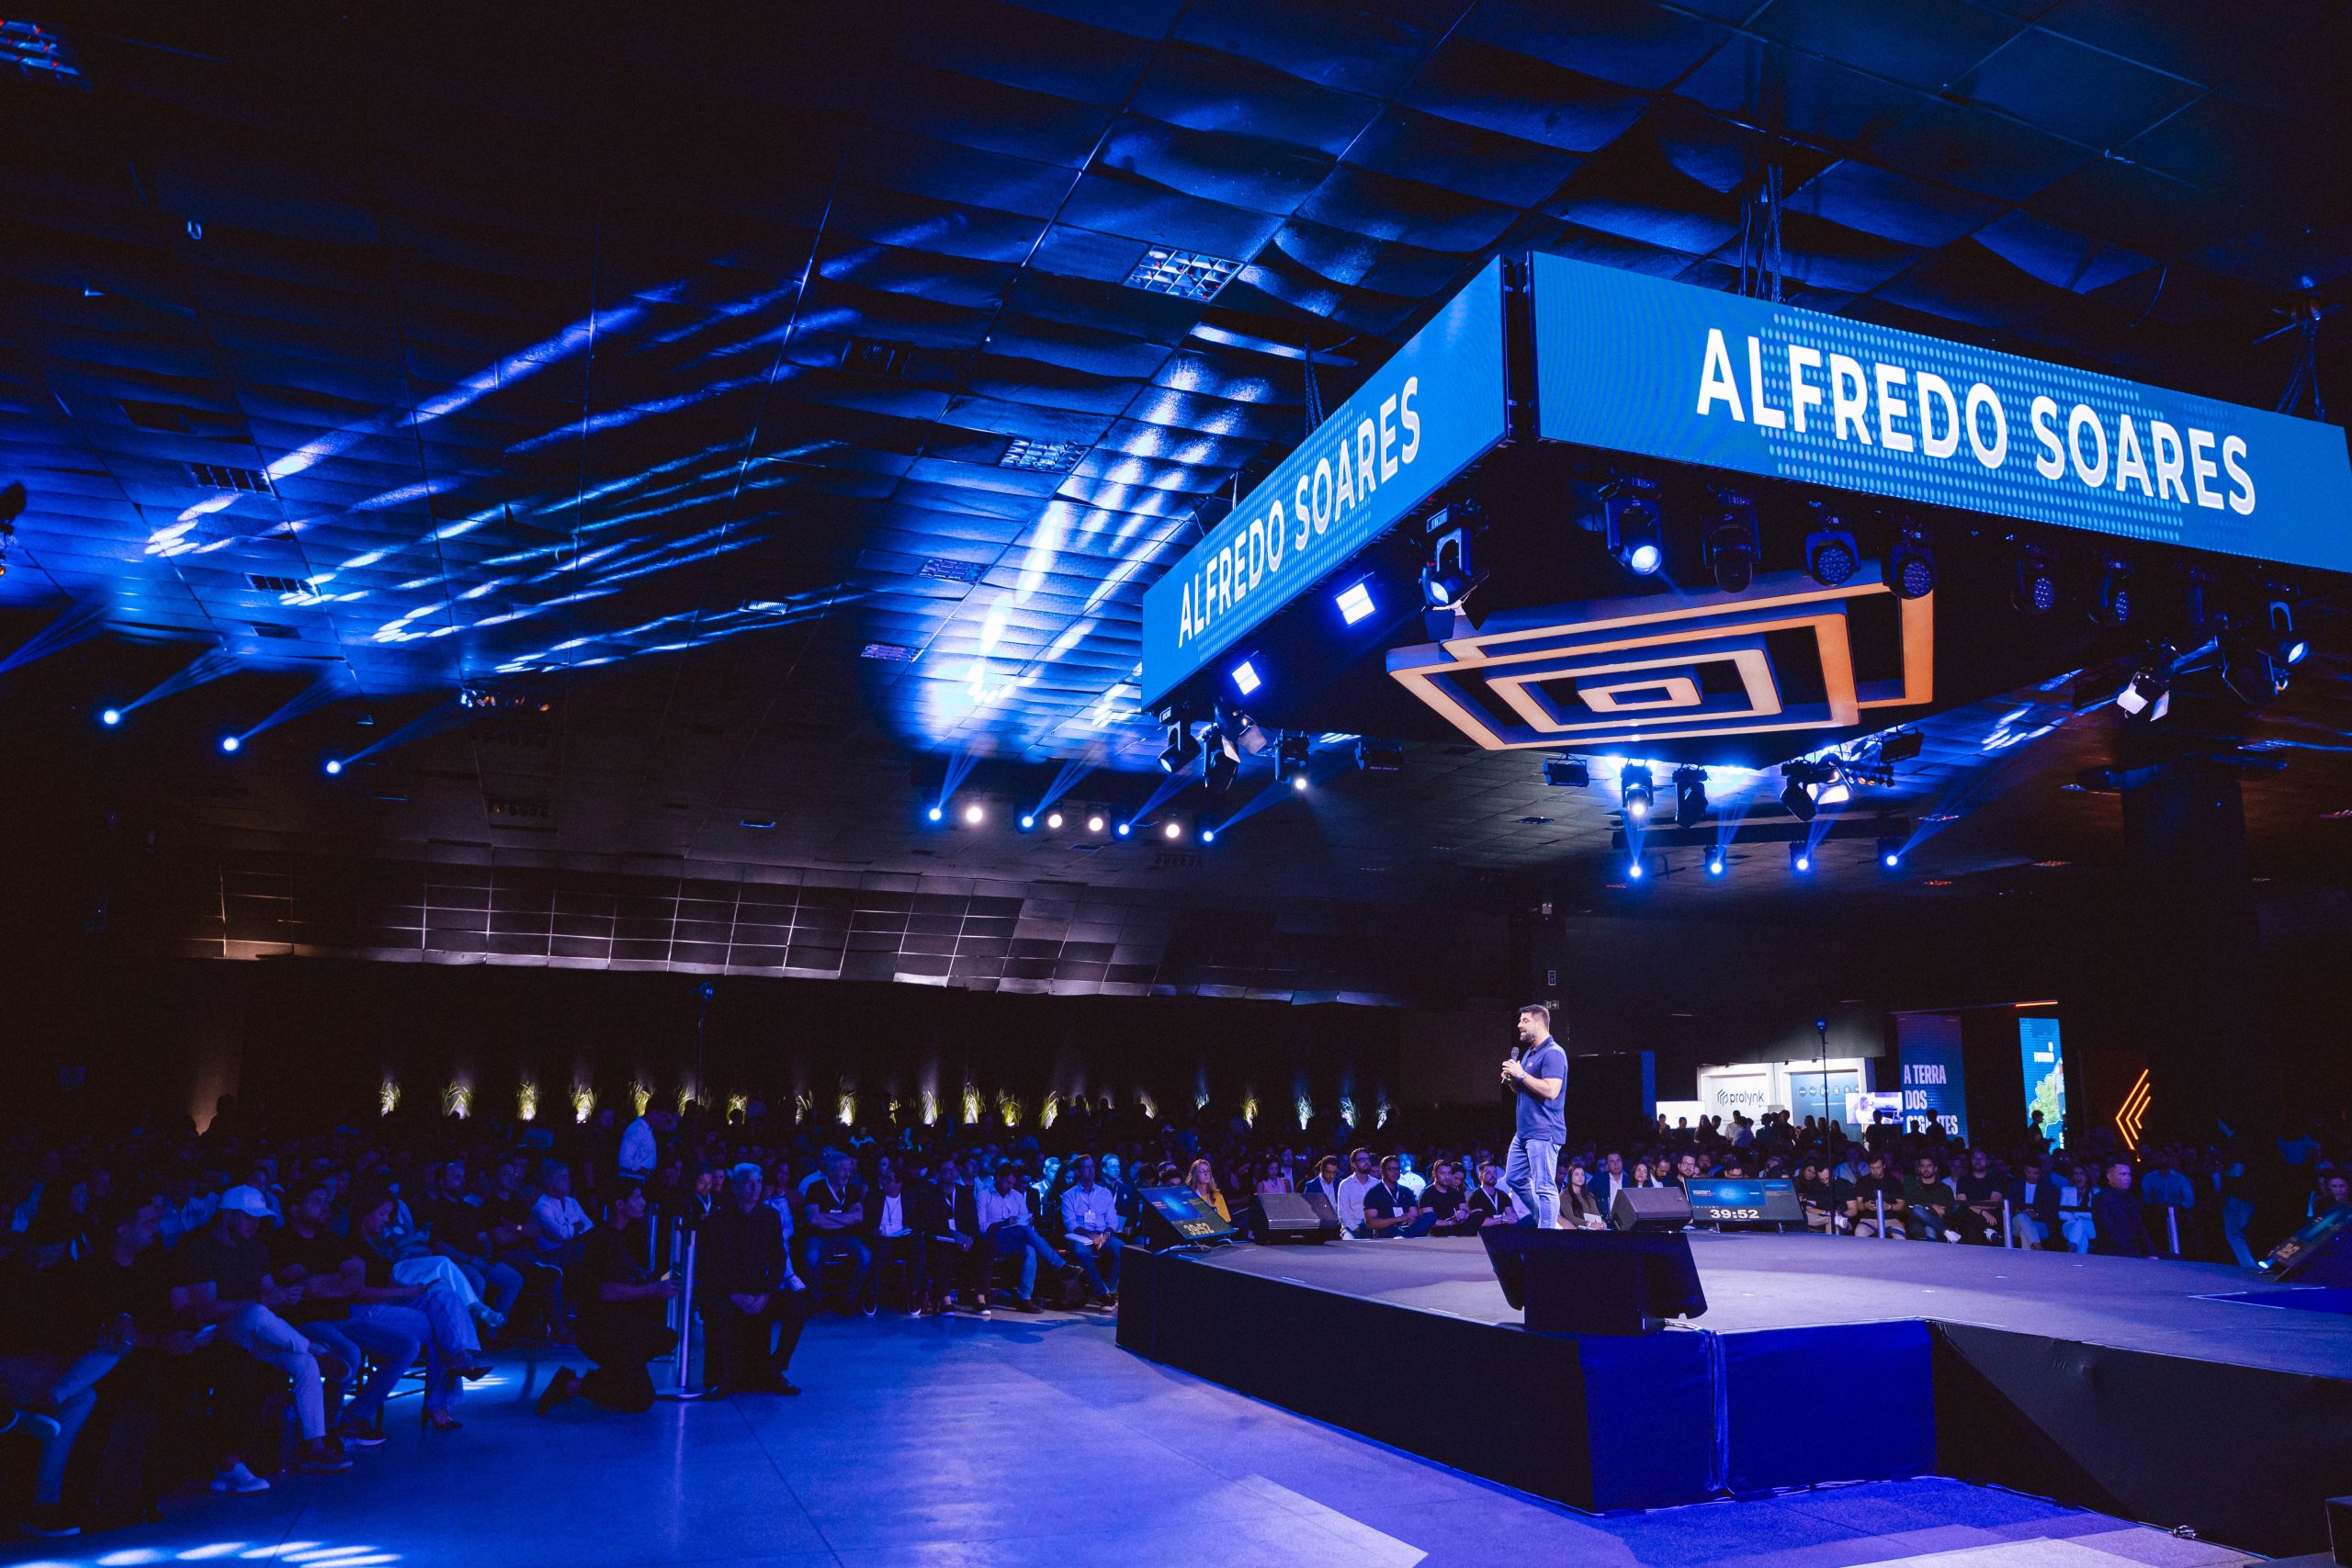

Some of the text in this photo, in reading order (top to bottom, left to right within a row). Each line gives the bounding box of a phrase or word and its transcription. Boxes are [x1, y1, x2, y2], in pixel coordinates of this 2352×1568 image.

[1696, 327, 2256, 516] ALFREDO SOARES
[1178, 376, 1420, 649] ALFREDO SOARES
[1904, 1065, 1947, 1084] A TERRA
[1729, 1089, 1765, 1106] prolynk
[1905, 1089, 1928, 1110] DOS
[1710, 1209, 1759, 1219] 39:52
[1183, 1223, 1215, 1236] 39:52
